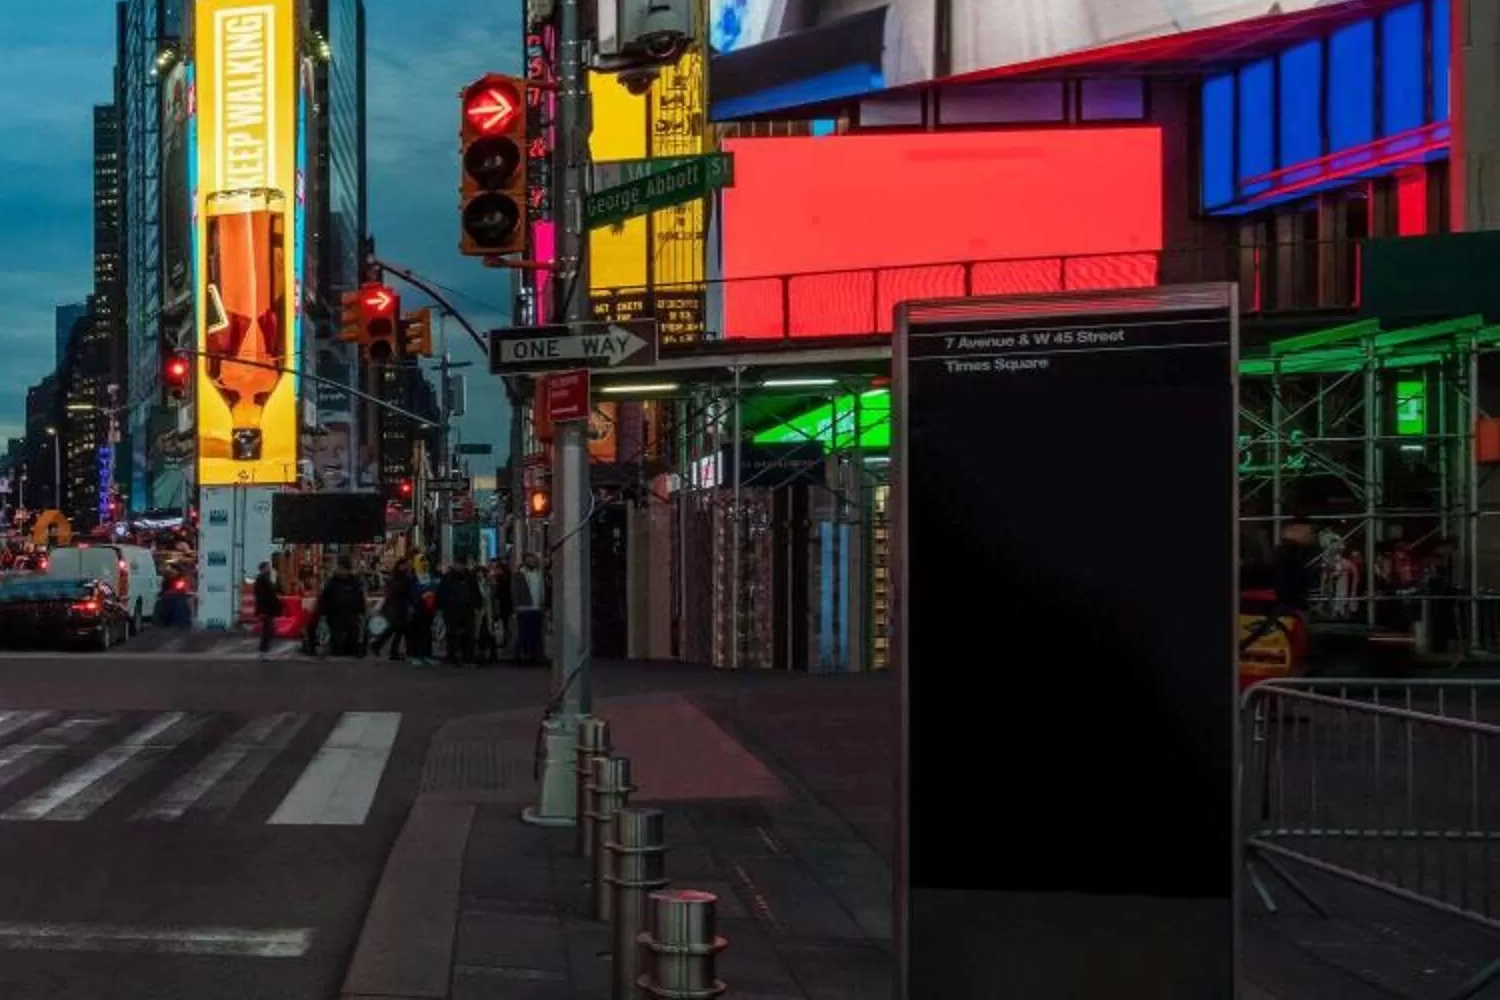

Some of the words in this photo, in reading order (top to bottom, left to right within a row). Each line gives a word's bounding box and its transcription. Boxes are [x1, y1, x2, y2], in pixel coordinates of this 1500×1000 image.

[225, 14, 265, 128] WALKING
[587, 184, 641, 218] George
[645, 164, 700, 198] Abbott
[513, 339, 561, 359] ONE
[581, 333, 631, 357] WAY
[944, 337, 954, 349] 7
[957, 335, 1015, 349] Avenue
[1018, 333, 1030, 346] &
[1031, 333, 1050, 346] W
[1053, 331, 1074, 344] 45
[1077, 329, 1125, 343] Street
[944, 359, 991, 374] Times
[993, 357, 1049, 373] Square
